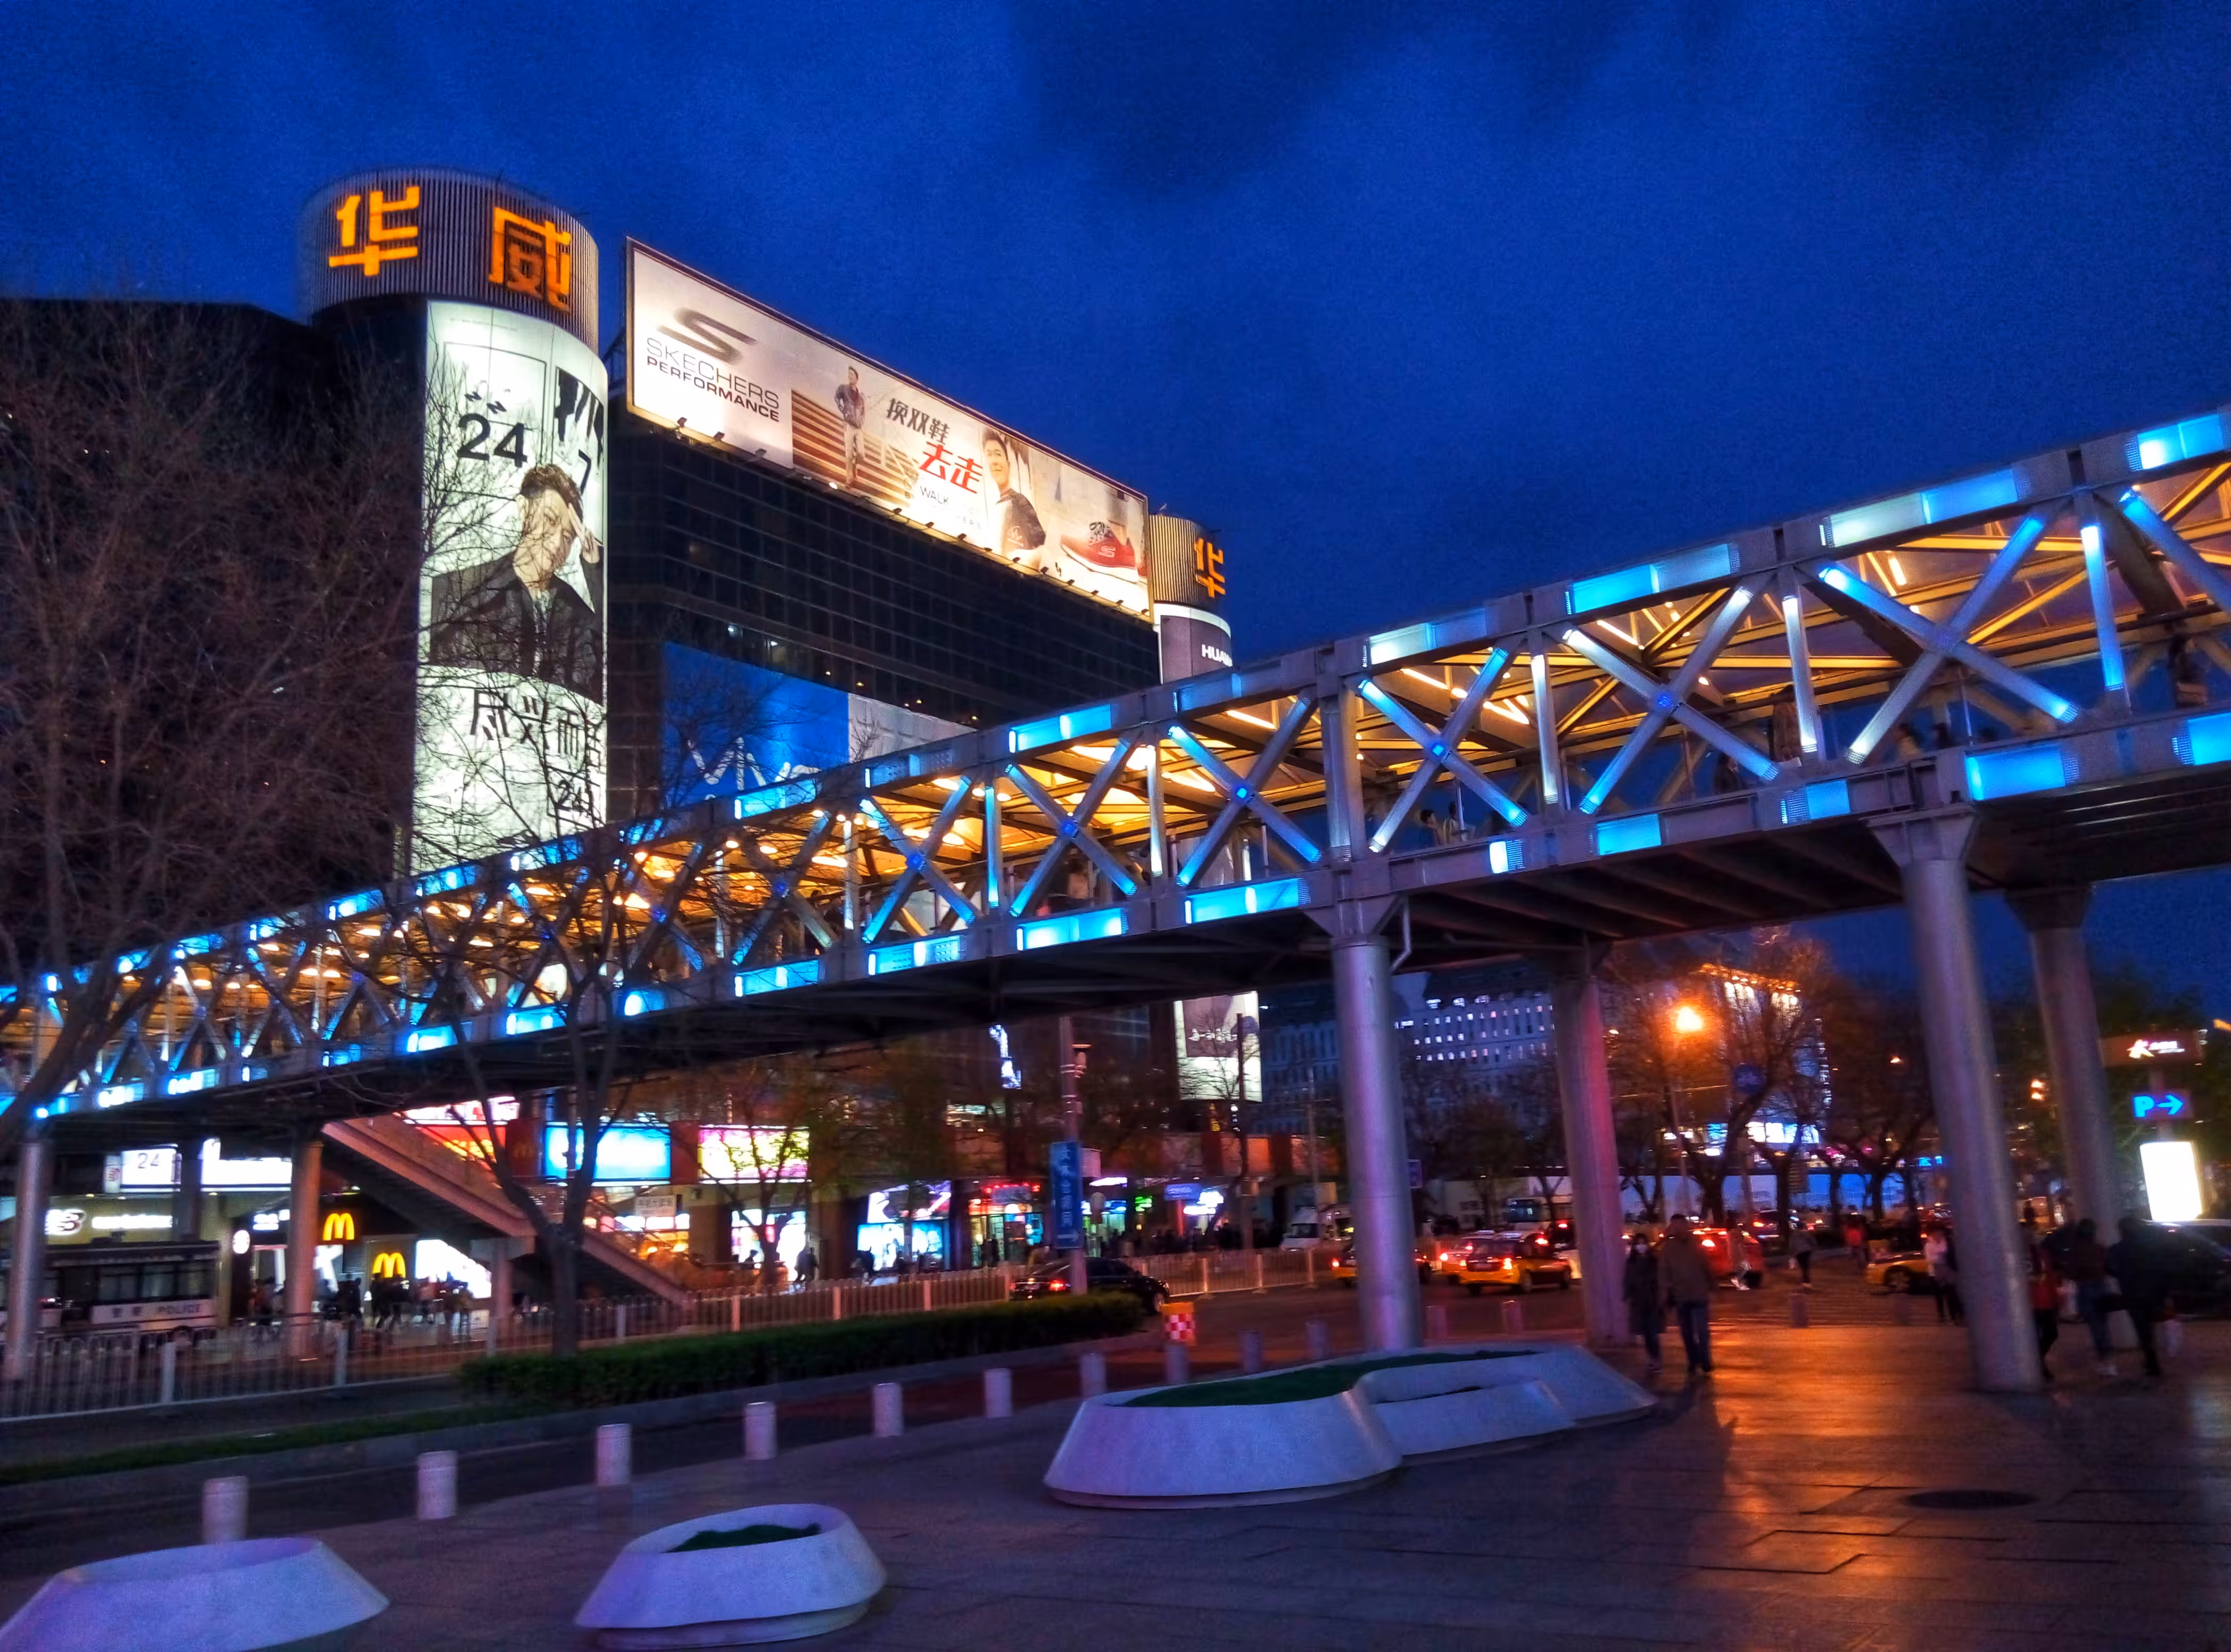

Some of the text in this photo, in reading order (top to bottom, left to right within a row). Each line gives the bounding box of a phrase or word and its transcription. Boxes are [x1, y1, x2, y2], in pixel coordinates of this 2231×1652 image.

[328, 186, 572, 314] 华威
[646, 337, 780, 410] SKECHERS
[646, 355, 780, 423] PERFORMANCE
[886, 397, 951, 445] 换双鞋
[919, 441, 984, 494] 去走
[919, 485, 950, 505] WALK
[1194, 537, 1226, 598] 华
[2133, 1095, 2154, 1117] P
